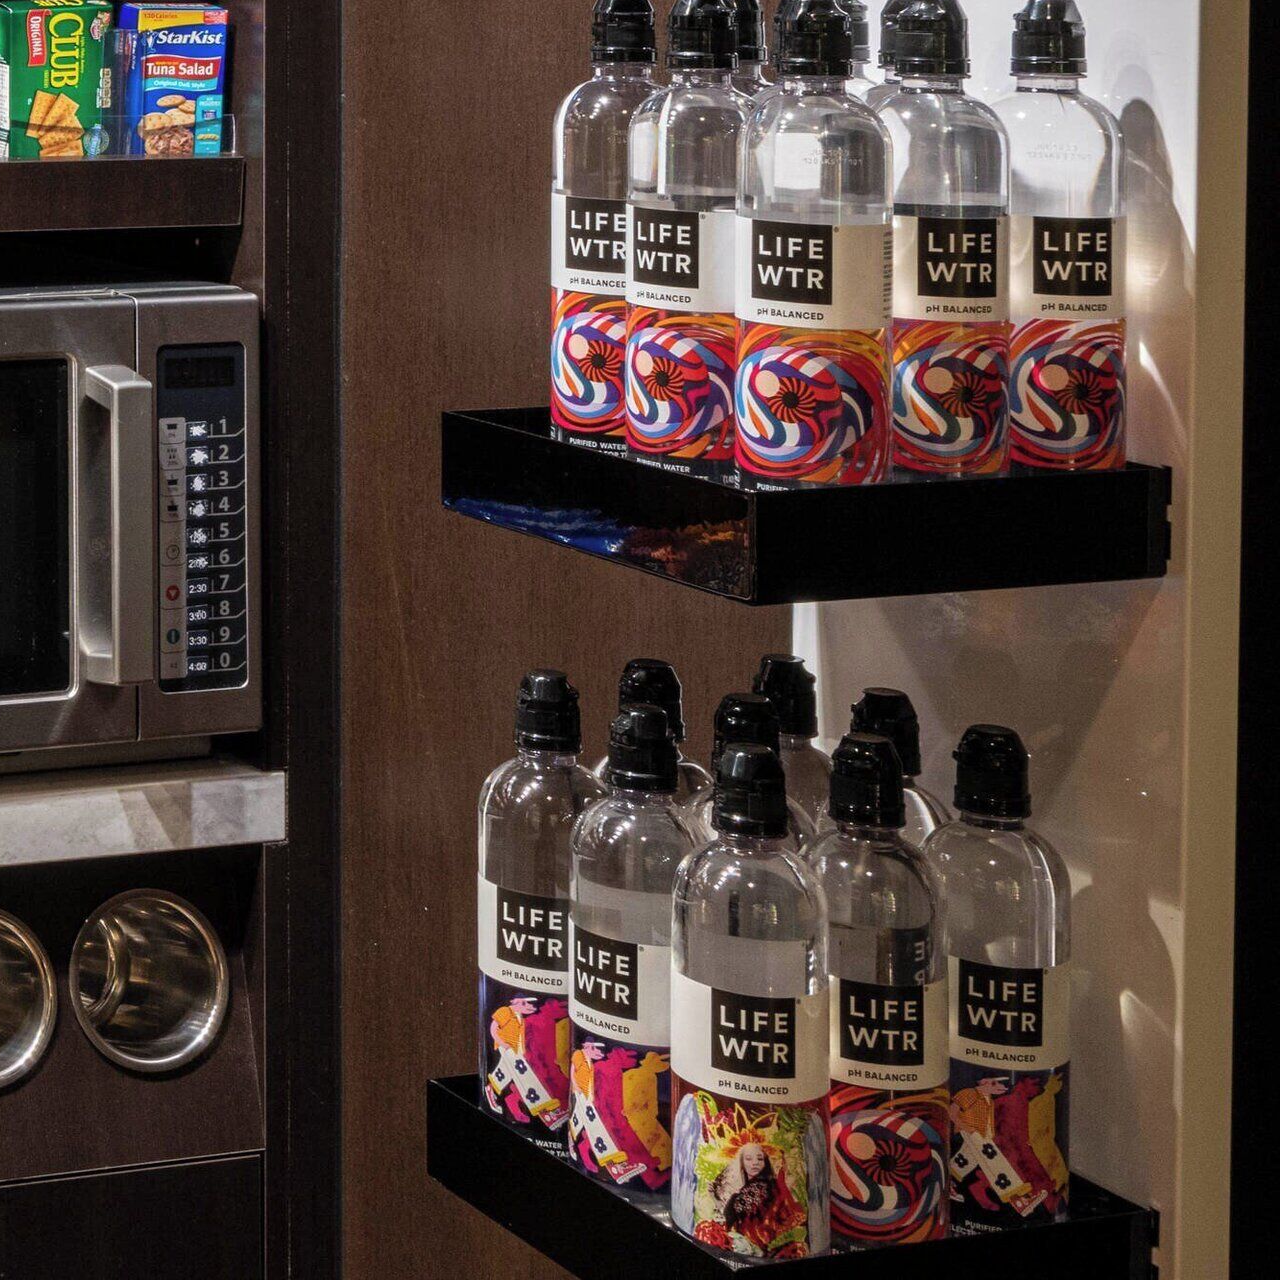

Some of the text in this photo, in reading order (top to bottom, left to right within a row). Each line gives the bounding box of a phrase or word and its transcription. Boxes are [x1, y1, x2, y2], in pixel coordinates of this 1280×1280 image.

[31, 16, 42, 58] ORIGINAL
[157, 31, 222, 46] StarKist
[49, 12, 83, 88] CLUB
[146, 62, 213, 76] Tuna Salad
[636, 225, 691, 245] LIFE
[758, 235, 824, 258] LIFE
[928, 233, 993, 252] LIFE
[1043, 232, 1107, 251] LIFE
[637, 250, 691, 273] WTR
[926, 262, 991, 283] WTR
[1042, 260, 1107, 281] WTR
[758, 264, 825, 289] WTR
[757, 307, 824, 320] pH BALANCED
[218, 446, 229, 459] 2
[189, 583, 207, 593] 2:30
[219, 575, 229, 590] 7
[189, 636, 207, 646] 3:30
[219, 627, 230, 641] 9
[502, 901, 562, 931] LIFE
[502, 932, 562, 958] WTR
[576, 944, 630, 976] LIFE
[576, 970, 629, 1004] WTR
[968, 976, 1036, 1002] LIFE
[720, 1005, 788, 1033] LIFE
[850, 996, 917, 1021] LIFE
[967, 1005, 1036, 1032] WTR
[849, 1026, 917, 1050] WTR
[719, 1035, 788, 1065] WTR
[966, 1049, 1035, 1063] pH BALANCED
